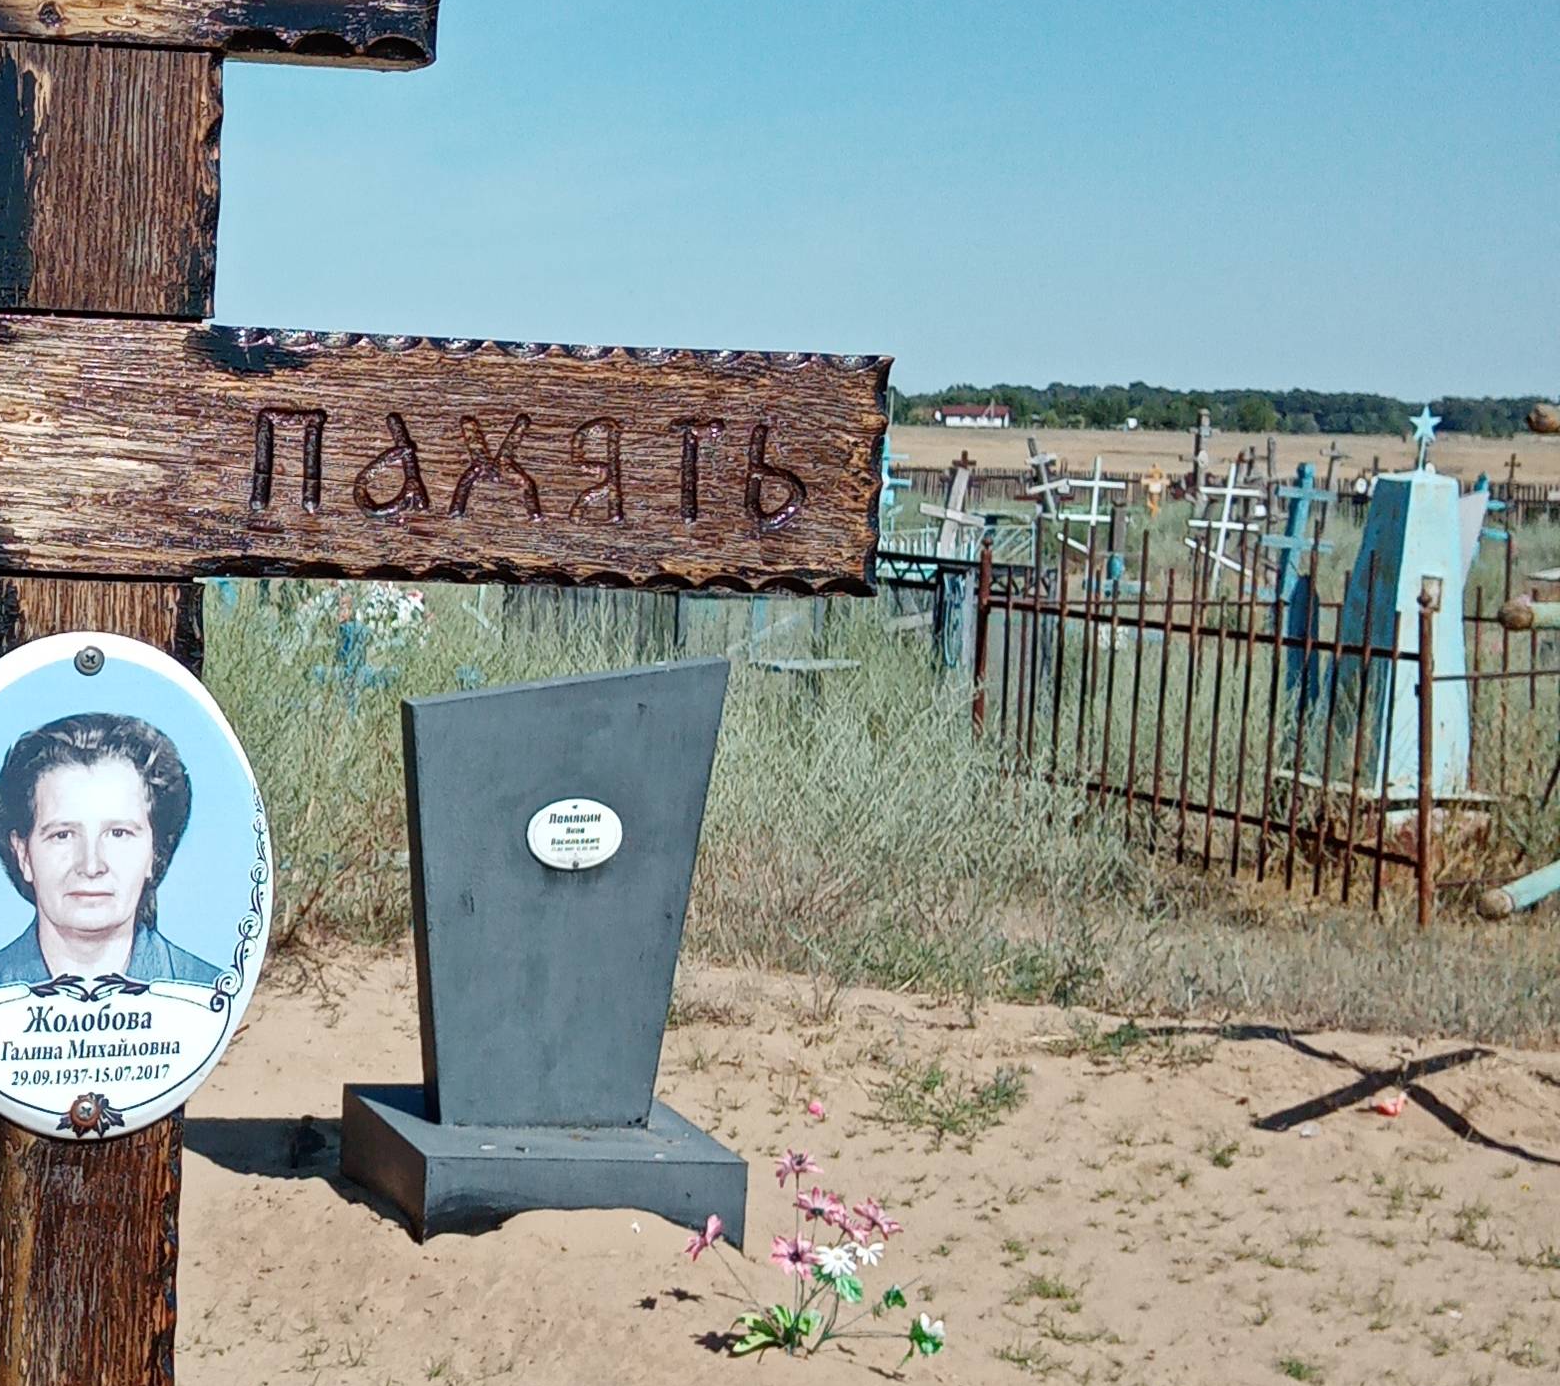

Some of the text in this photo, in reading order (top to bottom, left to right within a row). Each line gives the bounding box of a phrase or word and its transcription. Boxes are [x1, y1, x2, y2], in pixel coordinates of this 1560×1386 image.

[23, 1002, 153, 1033] Жолобова
[0, 1038, 181, 1062] Галина Михайловна
[11, 1063, 170, 1086] 29.09.1937-15.07.2017
